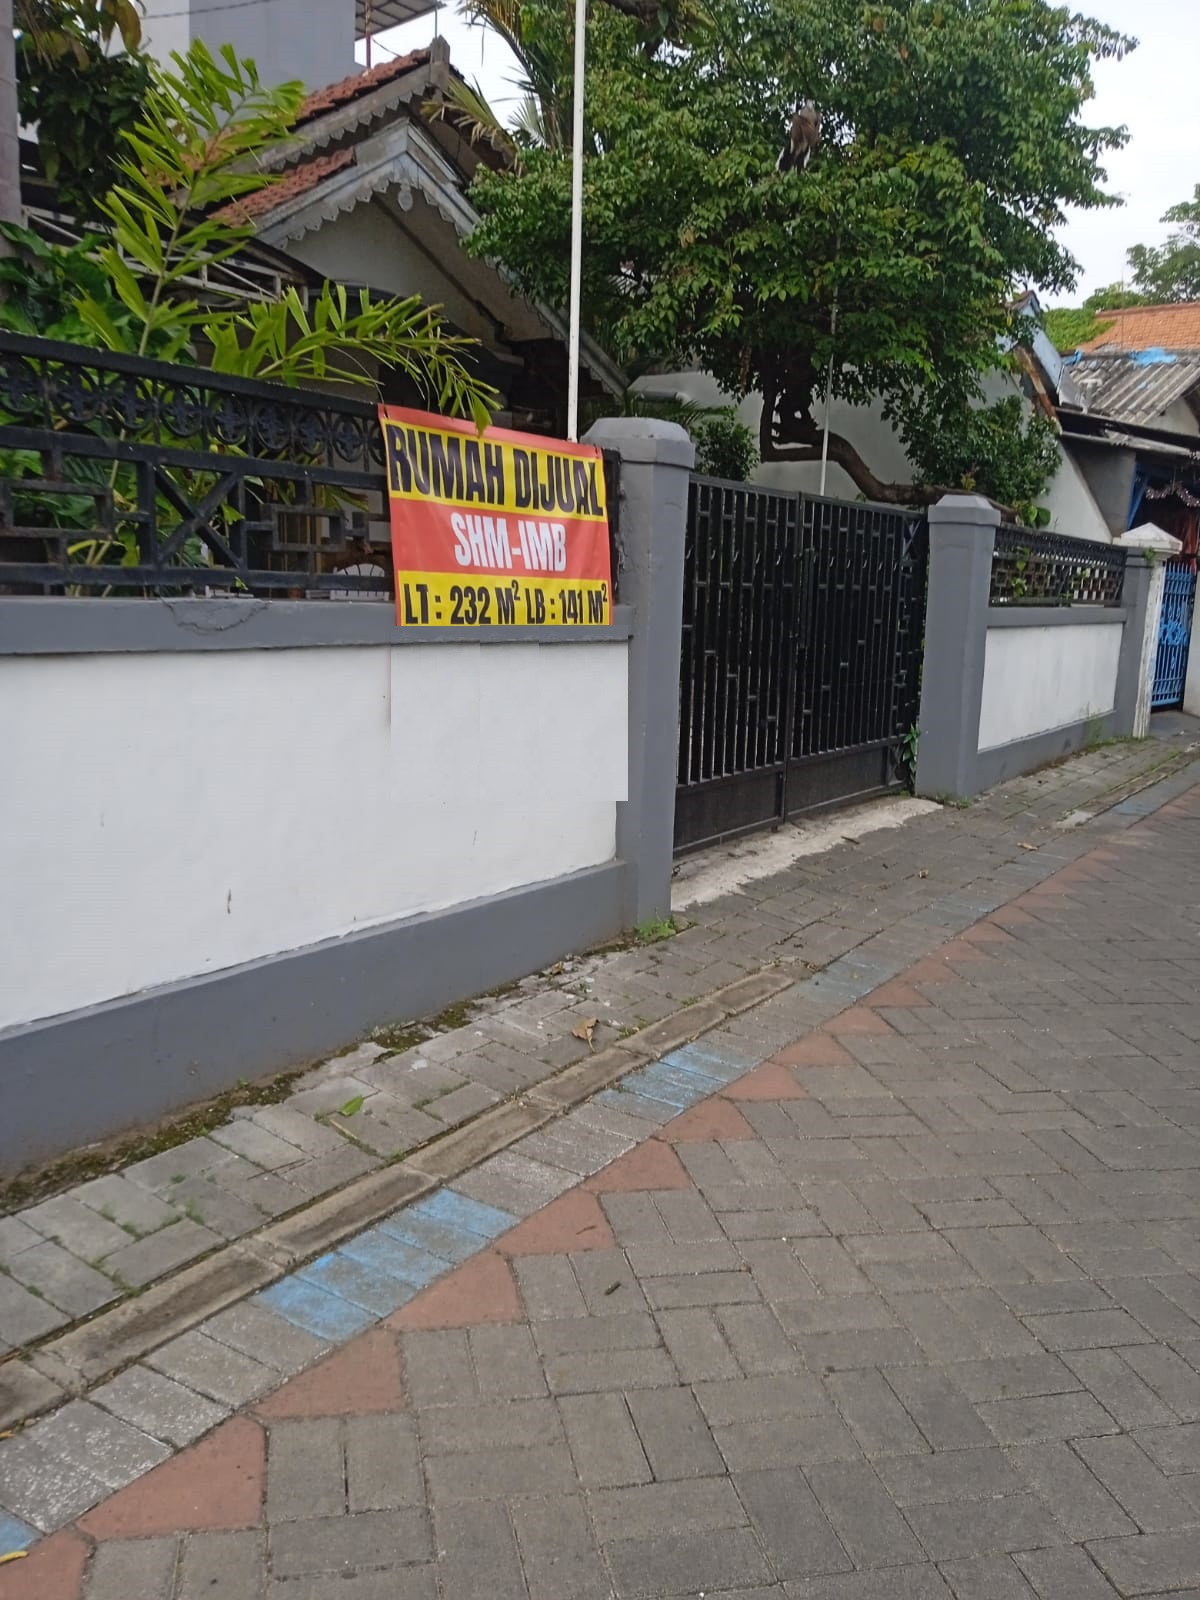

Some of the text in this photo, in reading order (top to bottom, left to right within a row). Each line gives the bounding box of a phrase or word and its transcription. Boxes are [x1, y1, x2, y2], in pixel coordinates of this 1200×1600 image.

[385, 424, 604, 517] RUMAH DIJUAL
[450, 512, 567, 572] SHM-IMB
[449, 585, 492, 625] 232
[559, 589, 584, 624] 141
